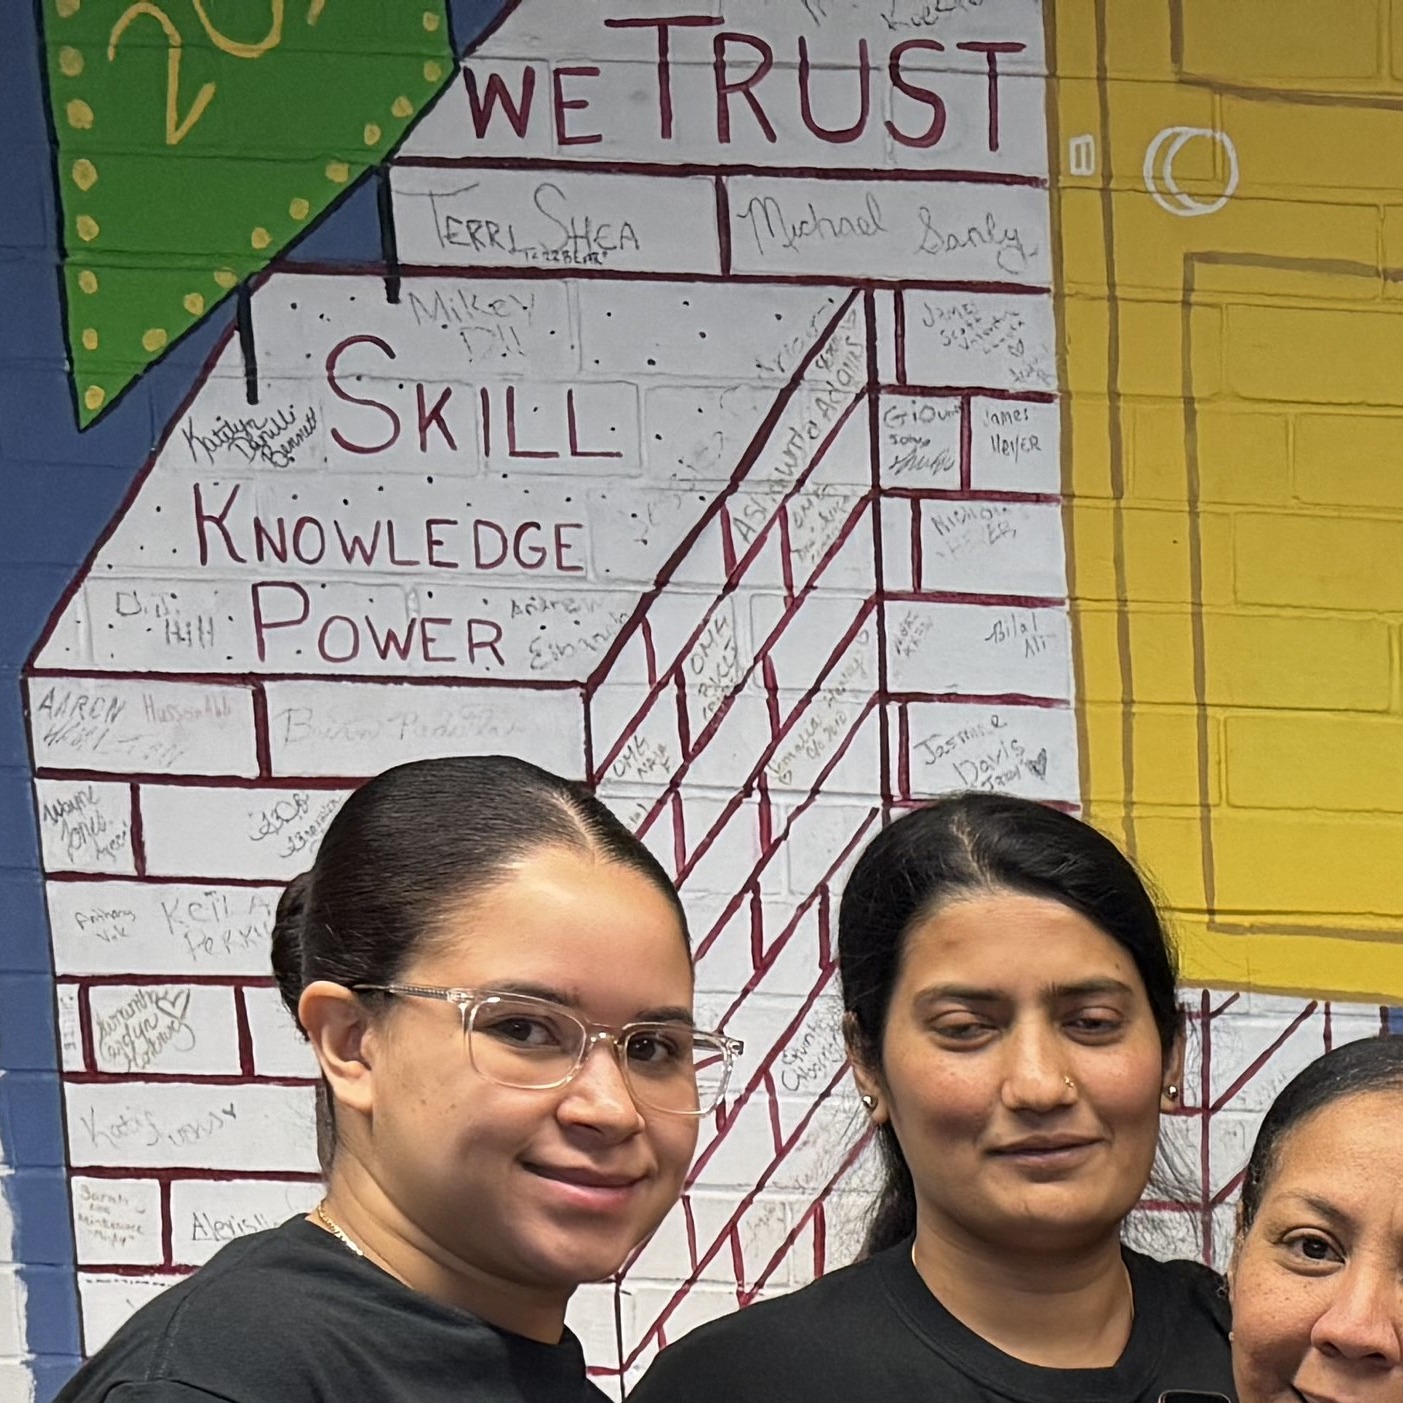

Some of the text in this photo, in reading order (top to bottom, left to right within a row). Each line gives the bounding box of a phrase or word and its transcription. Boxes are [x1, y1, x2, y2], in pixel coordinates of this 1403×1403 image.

[463, 15, 1027, 152] WE TRUST
[326, 335, 622, 458] SKILL
[193, 482, 583, 571] KNOWLEDGE
[251, 582, 504, 665] POWER
